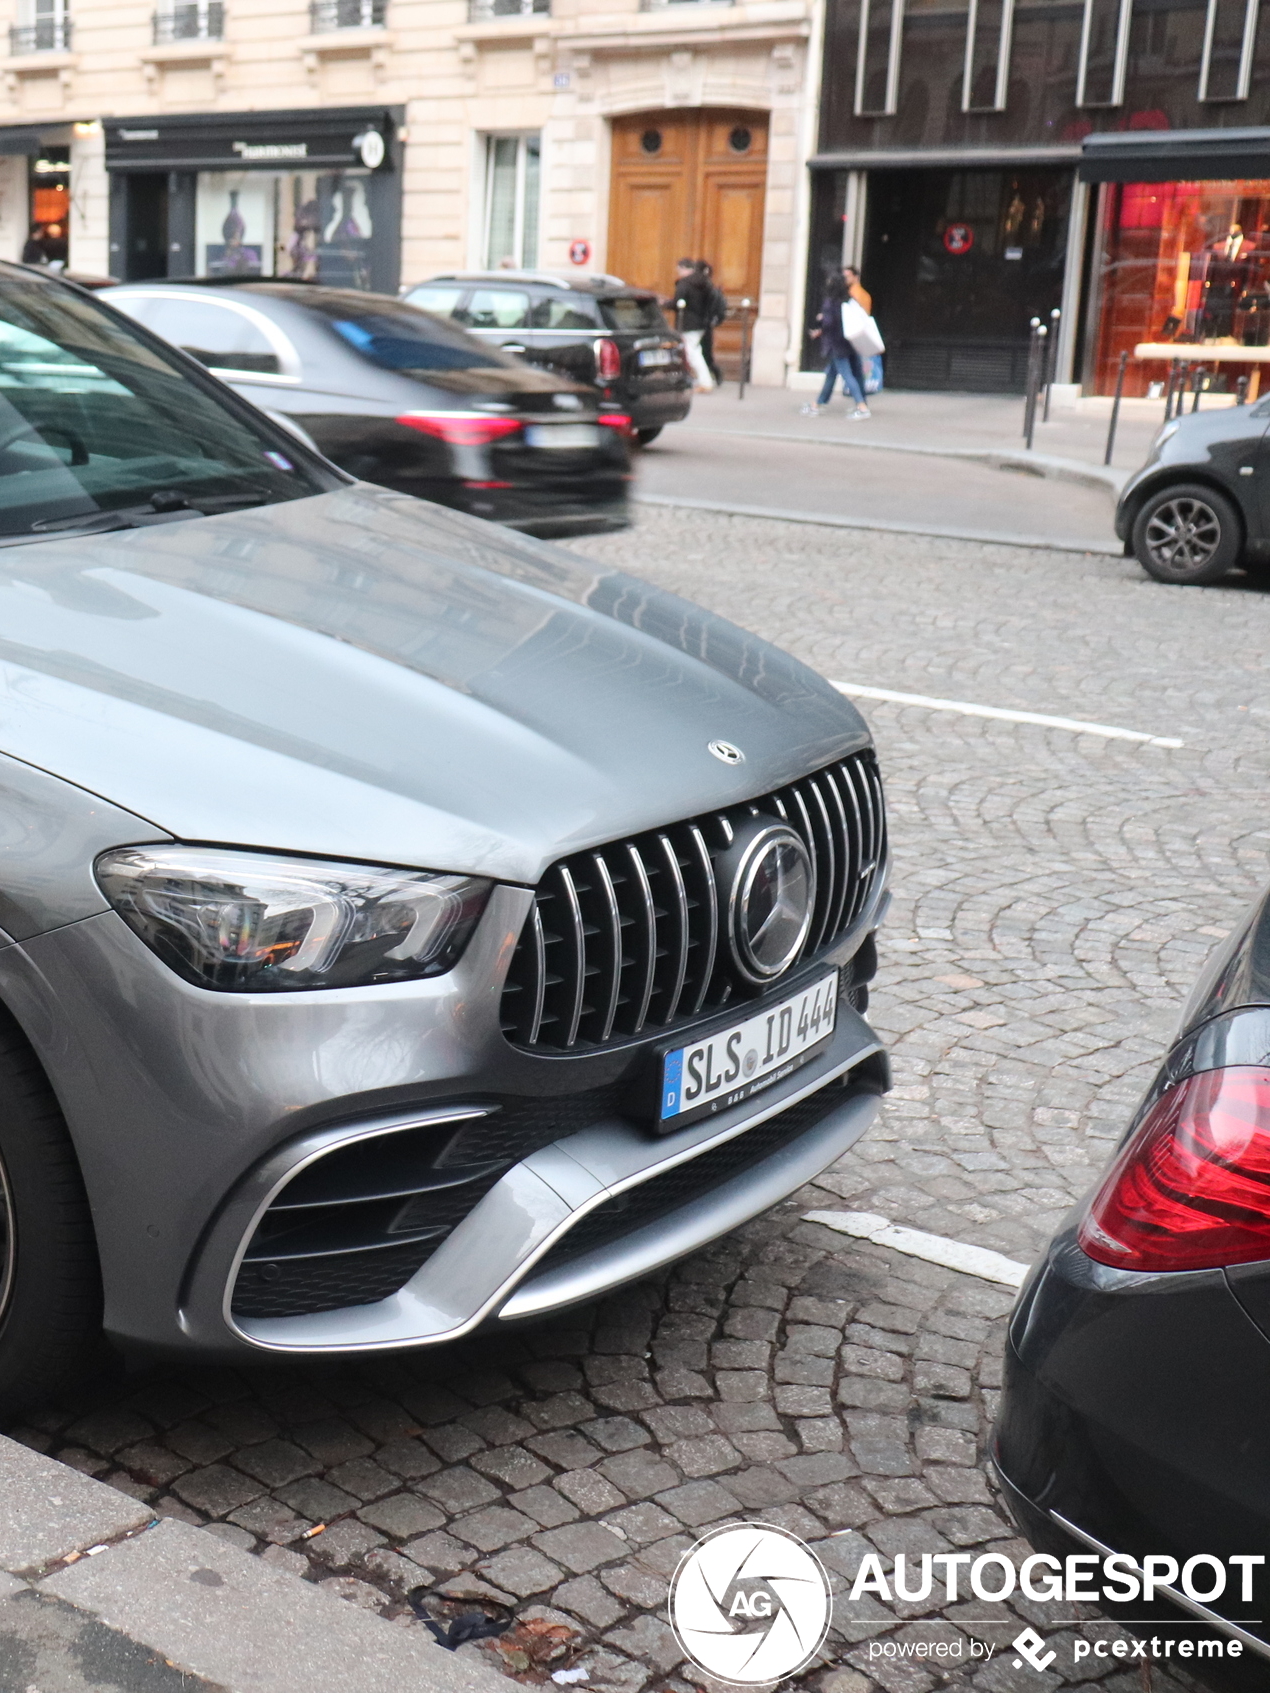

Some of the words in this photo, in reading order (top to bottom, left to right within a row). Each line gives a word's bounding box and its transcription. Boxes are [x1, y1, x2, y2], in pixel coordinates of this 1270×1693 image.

[685, 1031, 742, 1101] SLS
[762, 1005, 792, 1066] ID
[796, 979, 834, 1042] 444
[667, 1091, 676, 1108] D
